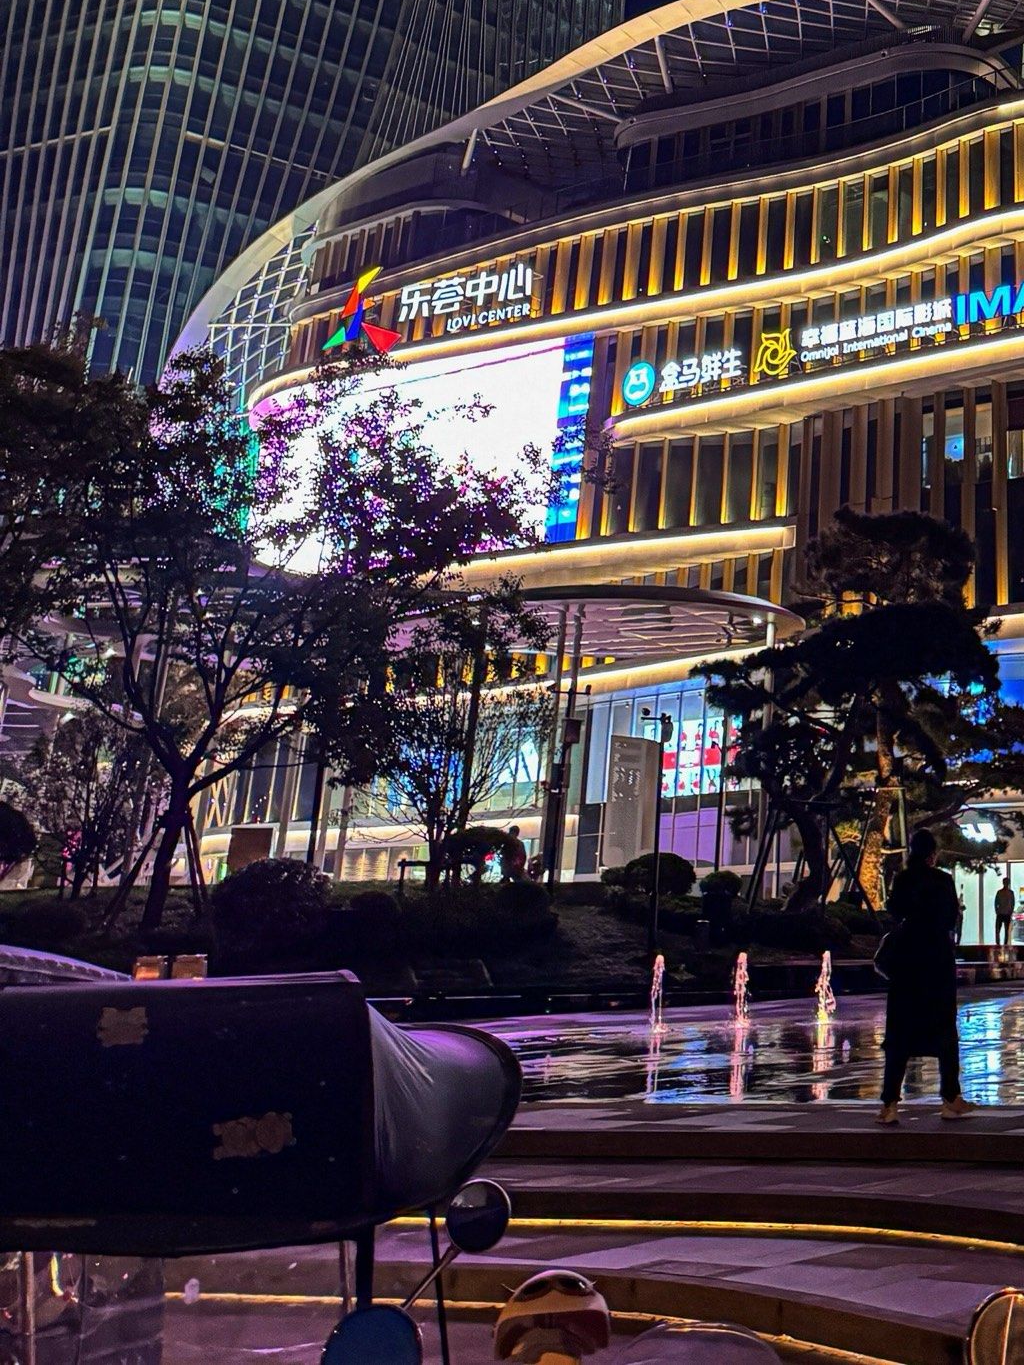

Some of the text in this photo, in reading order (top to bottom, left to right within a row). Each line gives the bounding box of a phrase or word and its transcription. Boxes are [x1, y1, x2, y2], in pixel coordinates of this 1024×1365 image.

[398, 263, 532, 322] 乐荟中心
[478, 303, 531, 325] CENTER
[843, 329, 908, 353] International
[912, 322, 952, 338] Cinema
[659, 348, 743, 392] 盒马鲜生
